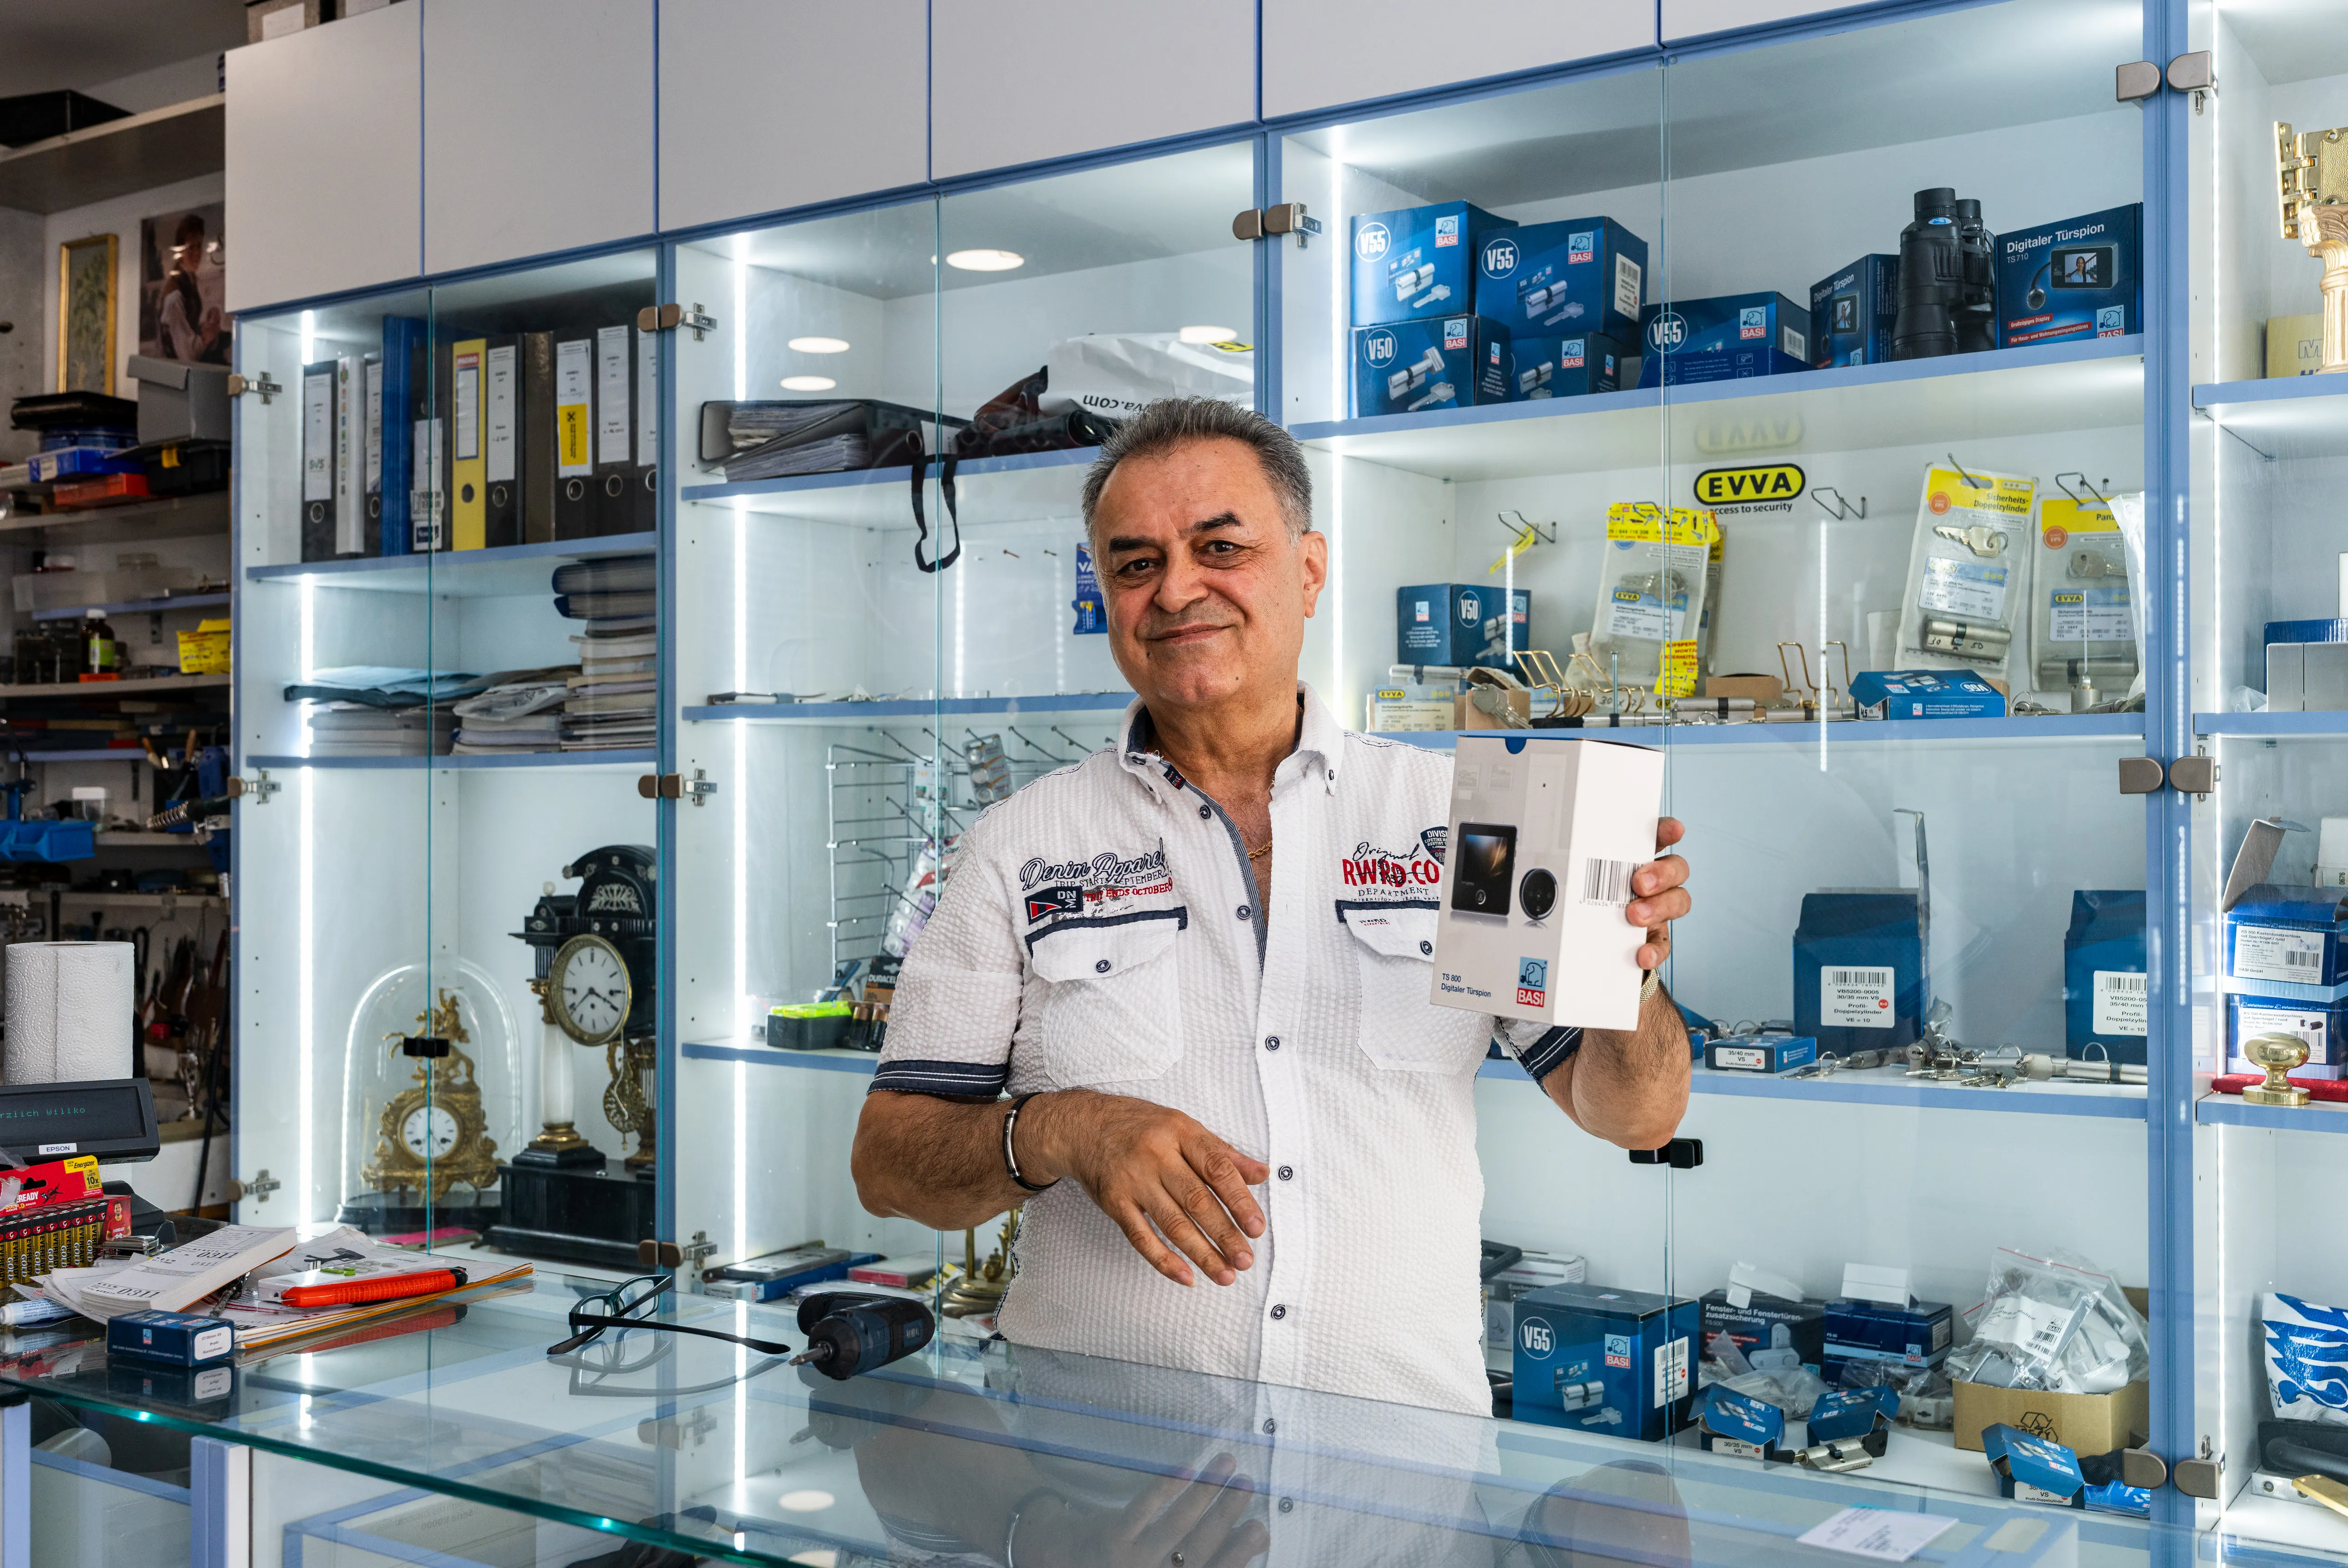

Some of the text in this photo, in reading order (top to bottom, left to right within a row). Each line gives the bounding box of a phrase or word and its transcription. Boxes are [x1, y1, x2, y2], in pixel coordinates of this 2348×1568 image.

[1360, 230, 1386, 255] V55
[1437, 235, 1457, 246] BASI
[2007, 223, 2105, 253] Digitaler Türspion
[1486, 247, 1514, 271] V55
[1570, 252, 1592, 263] BASI
[2017, 253, 2029, 262] 710
[1814, 273, 1854, 303] Digitaler Türspion
[2011, 316, 2050, 328] Großzügiges Display
[1653, 321, 1682, 345] V55
[1742, 327, 1764, 338] BASI
[1368, 337, 1393, 359] V50
[1445, 337, 1466, 349] BASI
[1563, 357, 1583, 367] BASI
[1708, 472, 1792, 498] EVVA
[1987, 493, 2029, 504] Sicherheits-
[1742, 505, 1751, 513] to
[1753, 502, 1793, 512] security
[1974, 500, 2028, 513] Doppelzylinder
[1461, 599, 1478, 620] V50
[1928, 637, 1941, 645] 30
[1353, 841, 1420, 862] Original
[1019, 837, 1165, 891] Denim Apparel
[1079, 877, 1108, 887] STARTS
[1113, 870, 1162, 885] SEPTEMBER
[1084, 883, 1169, 902] TRIP ENDS OCTOBER
[1358, 886, 1429, 898] DEPARTMENT
[2257, 931, 2301, 939] Kastenzusatzschloss
[1451, 975, 1462, 983] 800
[1441, 982, 1491, 998] Digitaler Türspion
[1518, 989, 1544, 1006] BASI
[46, 1107, 85, 1116] Willko
[74, 1160, 95, 1169] Energizer
[87, 1177, 99, 1185] 10x
[116, 1288, 162, 1298] 0311
[1706, 1304, 1803, 1321] Fenster- und Fenstertüren-
[1706, 1312, 1766, 1325] zusatzsicherung
[1524, 1325, 1550, 1352] V55
[1607, 1356, 1629, 1367] BASI
